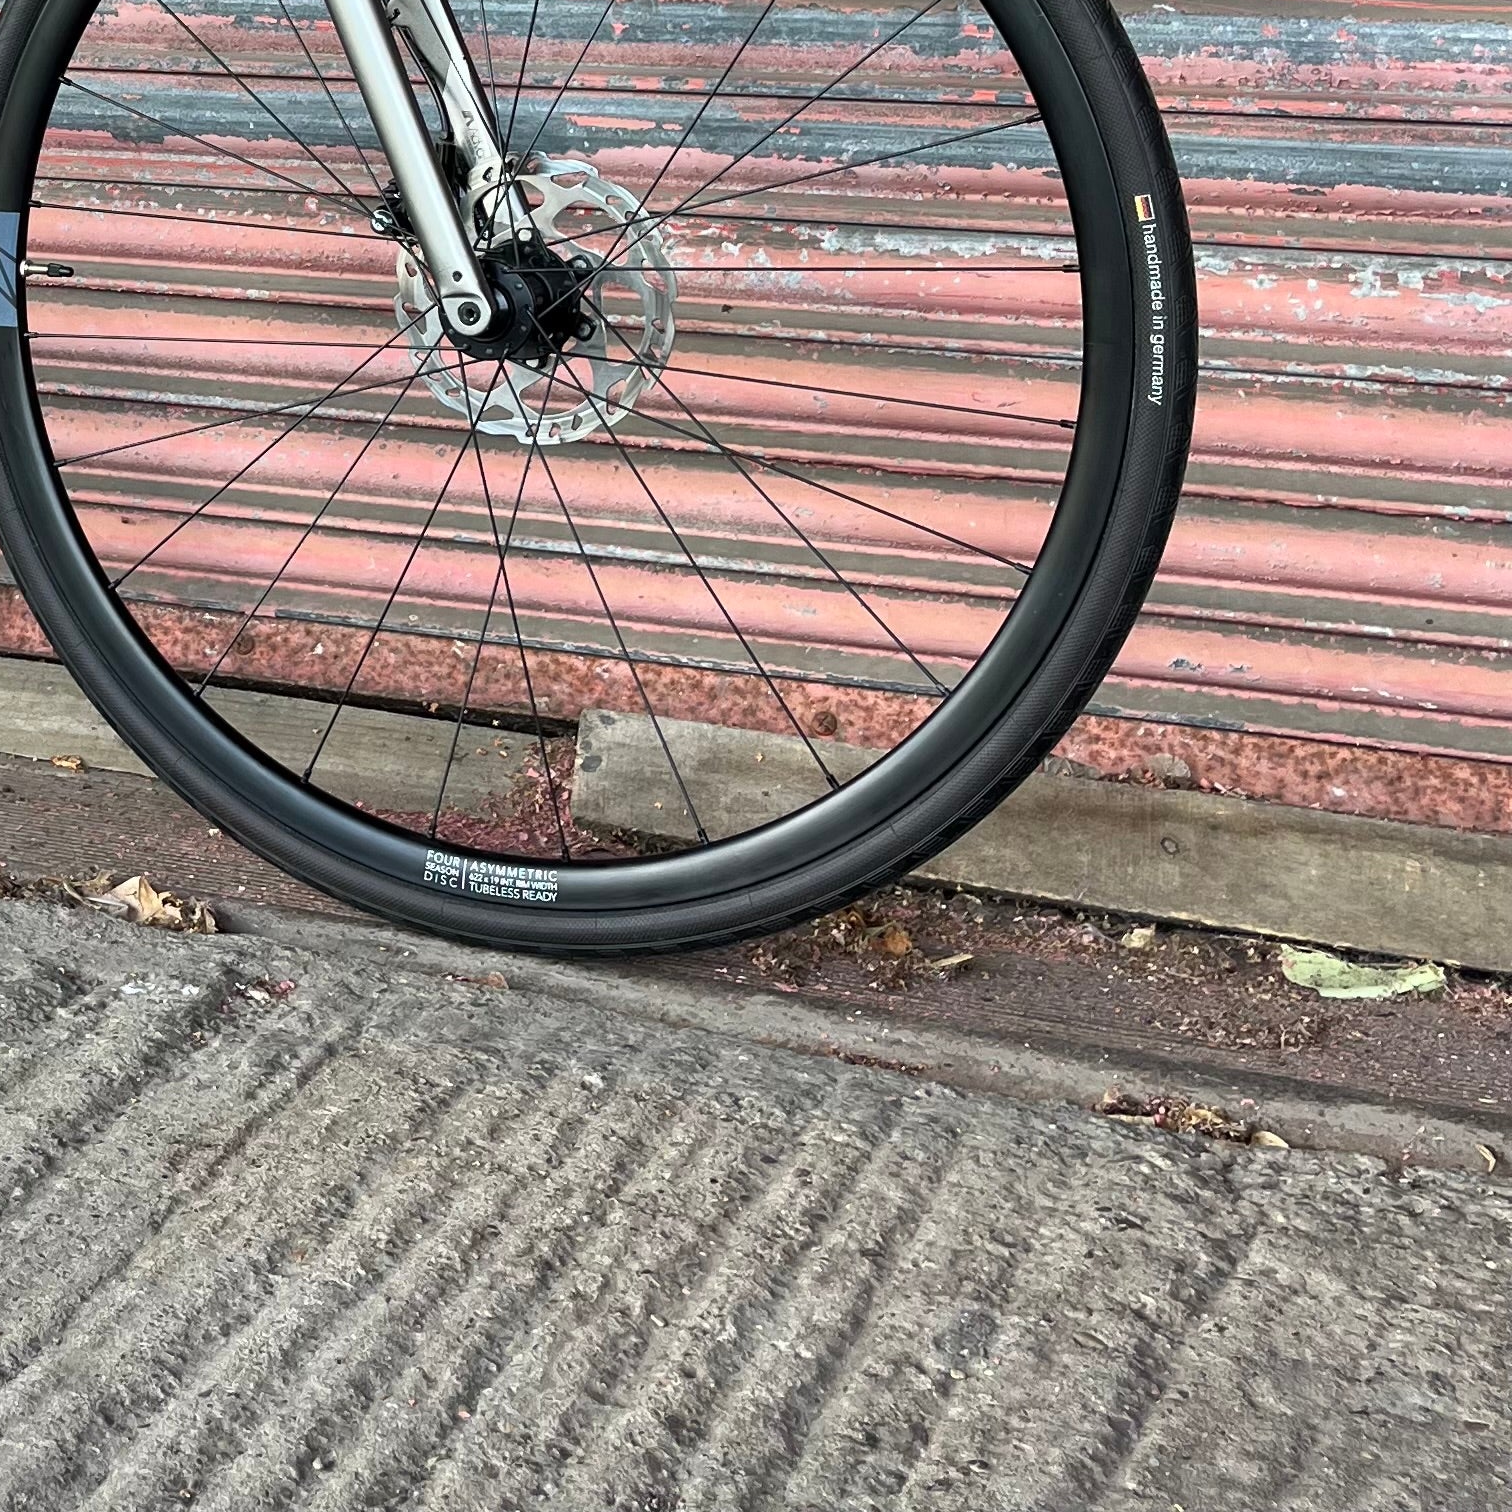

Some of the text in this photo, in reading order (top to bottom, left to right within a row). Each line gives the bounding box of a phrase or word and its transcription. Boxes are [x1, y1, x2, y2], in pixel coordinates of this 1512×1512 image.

[1142, 223, 1168, 406] handmade in germany
[427, 849, 461, 868] FOUR
[423, 870, 458, 888] DISC
[424, 861, 460, 877] SEASON
[469, 860, 558, 882] ASYMMETRIC
[469, 881, 558, 902] TUBELESS READY
